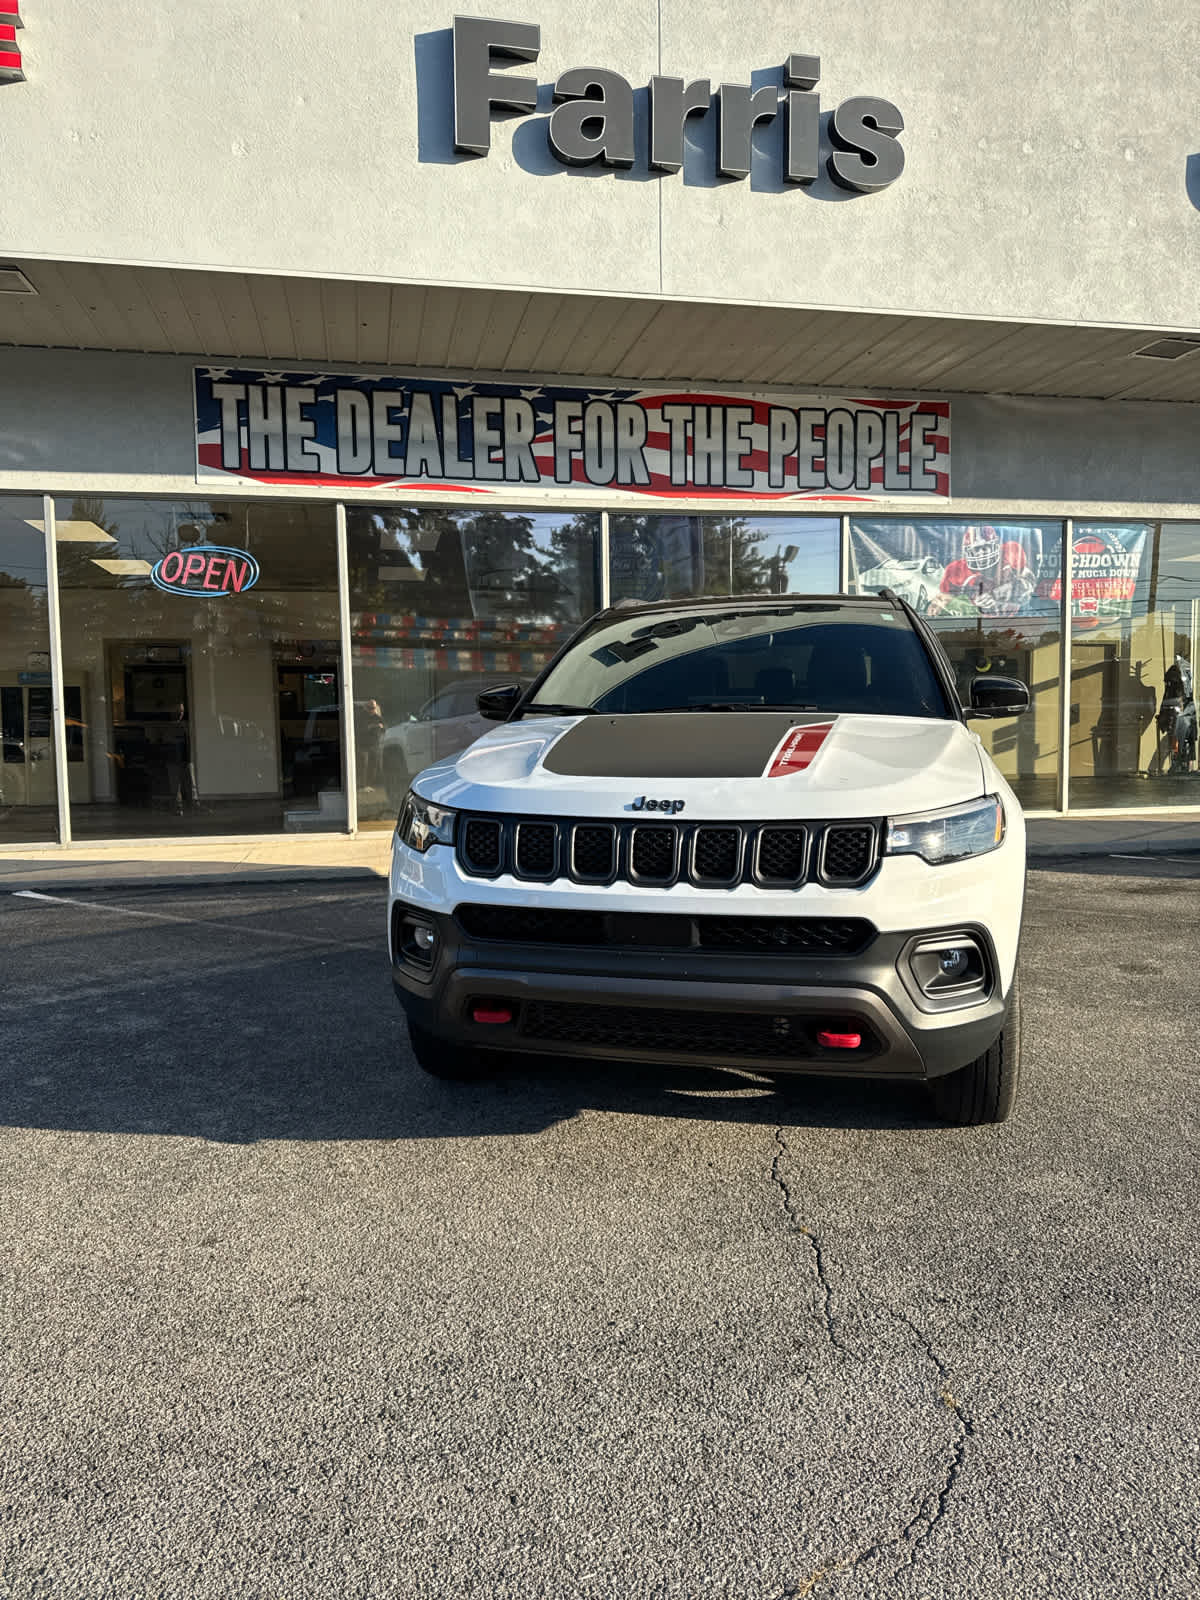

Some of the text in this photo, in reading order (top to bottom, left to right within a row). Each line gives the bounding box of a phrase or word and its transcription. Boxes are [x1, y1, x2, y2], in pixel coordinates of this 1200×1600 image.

[453, 15, 905, 193] Farris
[211, 382, 939, 491] THE DEALER FOR THE PEOPLE
[161, 552, 248, 593] OPEN
[1036, 553, 1140, 568] TOCHDOWN
[1079, 569, 1107, 577] MUCH
[631, 795, 686, 815] Jeep
